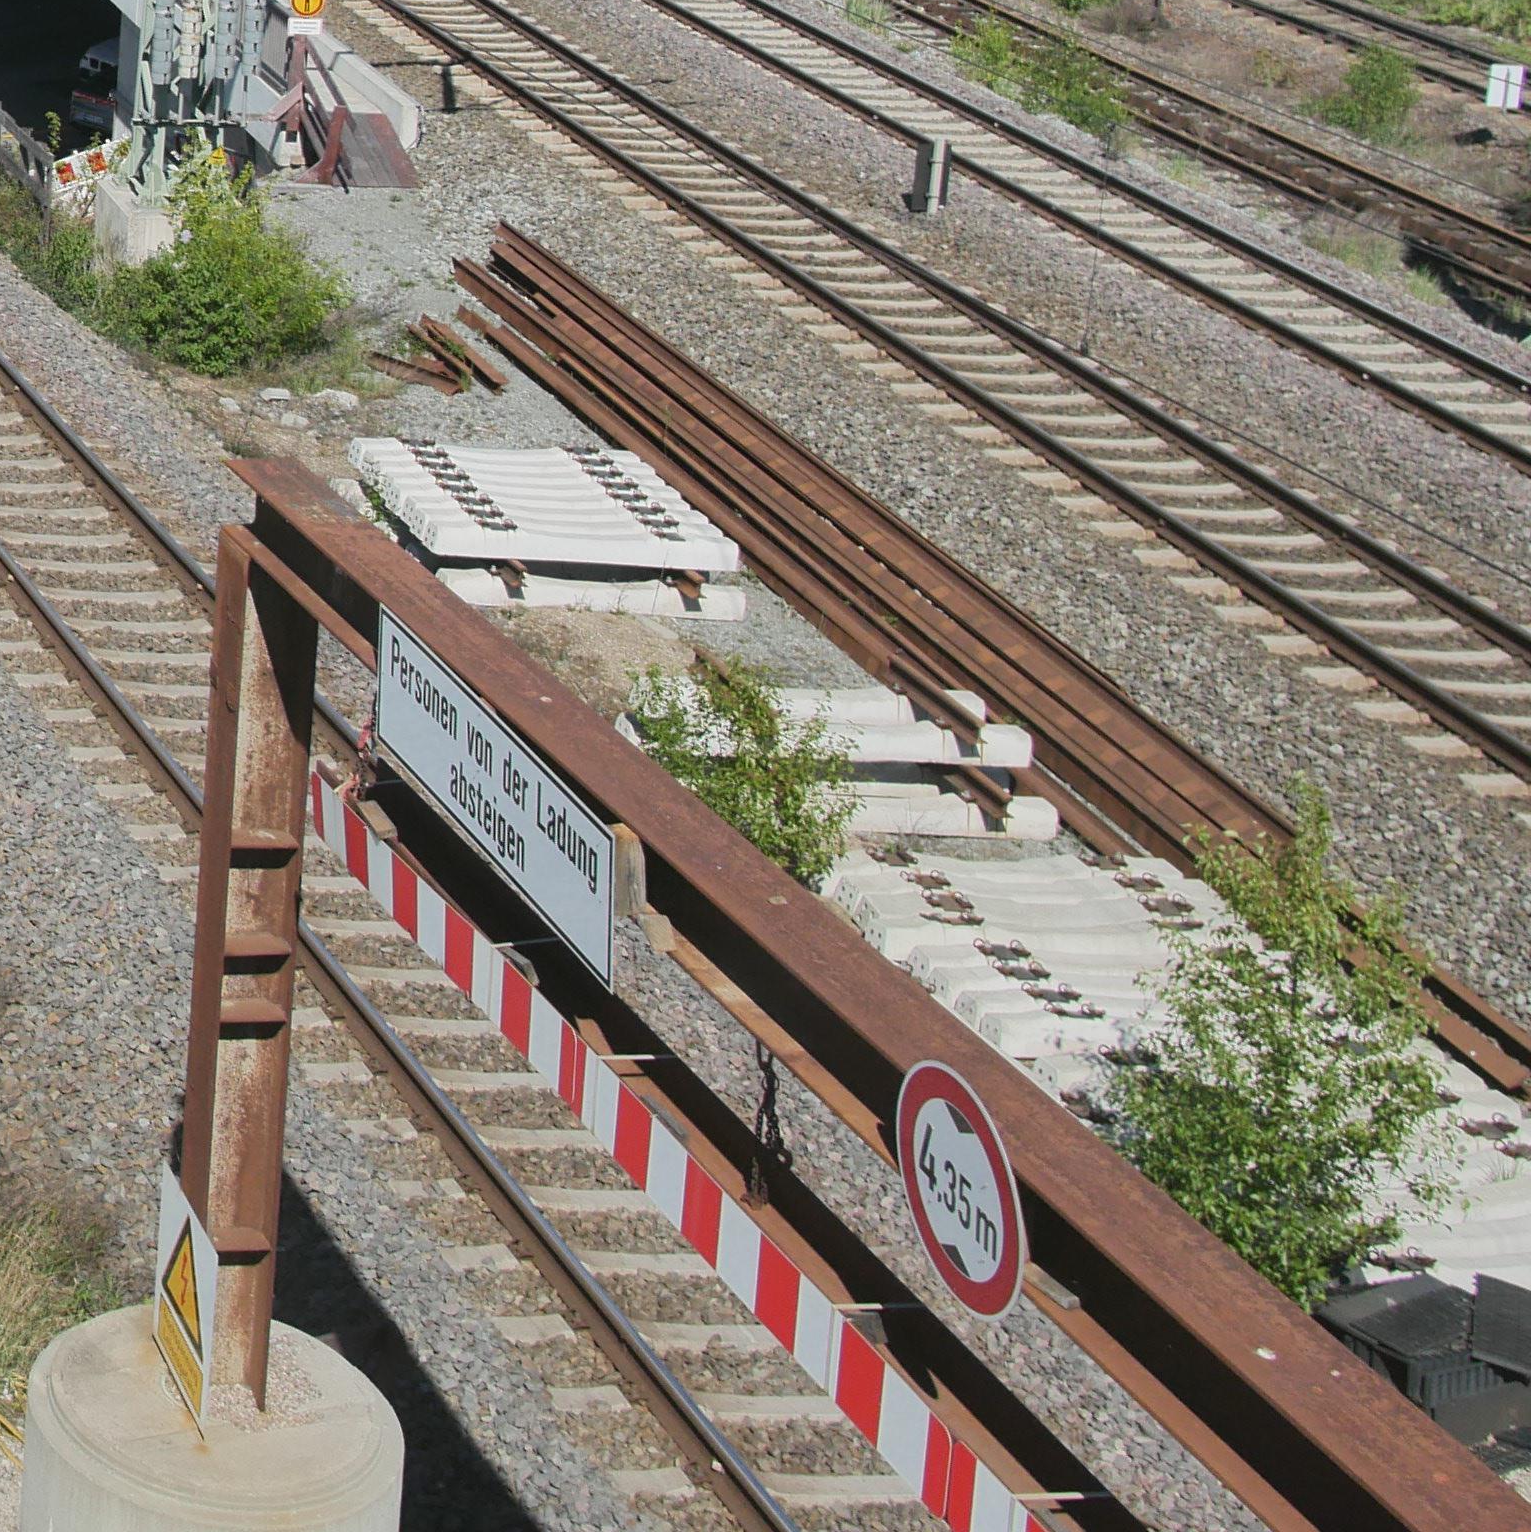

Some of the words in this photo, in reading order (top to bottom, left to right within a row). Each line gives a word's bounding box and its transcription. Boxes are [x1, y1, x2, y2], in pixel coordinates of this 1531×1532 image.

[390, 634, 458, 741] Personen
[466, 719, 493, 778] von
[502, 750, 529, 812] der
[536, 780, 599, 895] Ladung
[450, 761, 526, 873] absteigen
[975, 1205, 998, 1263] m
